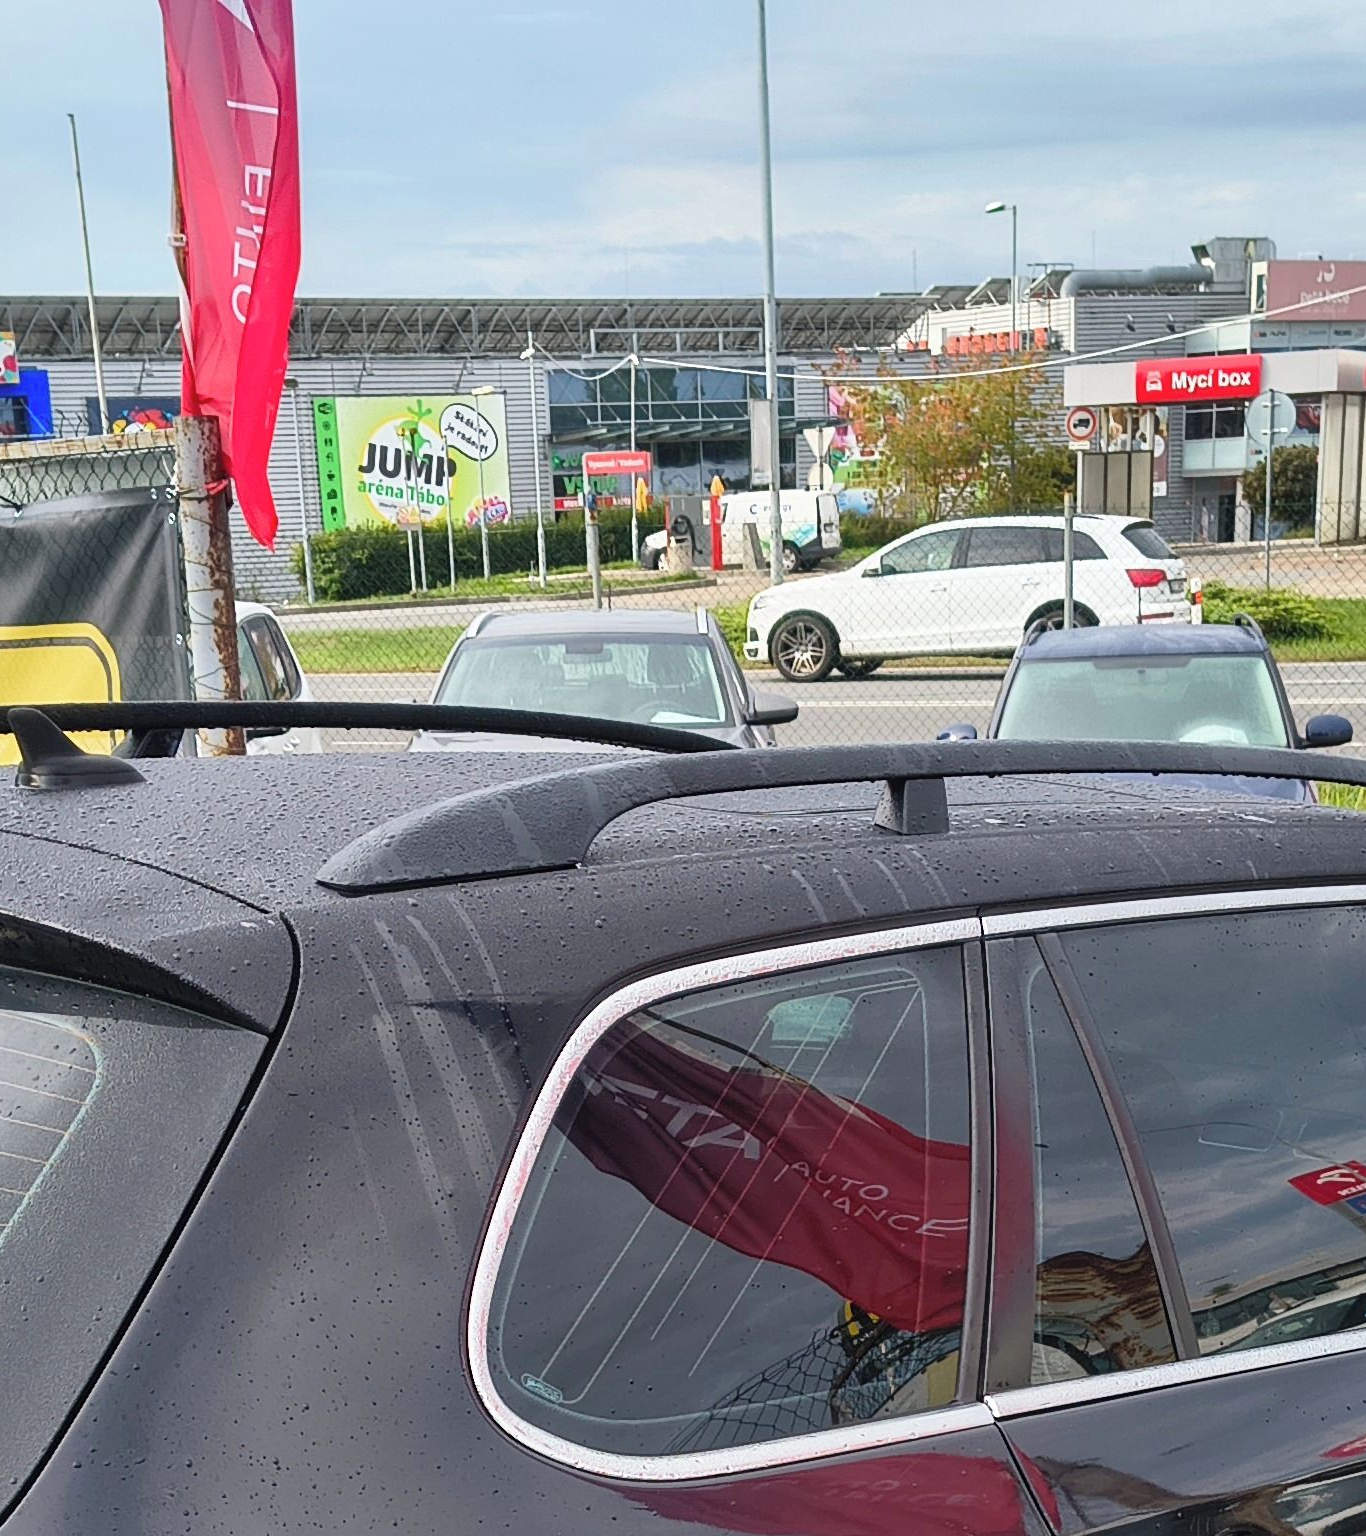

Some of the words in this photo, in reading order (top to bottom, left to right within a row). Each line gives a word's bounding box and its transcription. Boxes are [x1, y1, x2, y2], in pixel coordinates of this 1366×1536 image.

[1171, 369, 1214, 393] Mycí
[1218, 370, 1252, 387] box
[358, 442, 457, 487] JUMP
[357, 479, 404, 499] aréna
[407, 485, 454, 506] Tábo
[791, 1161, 889, 1200] AUTO
